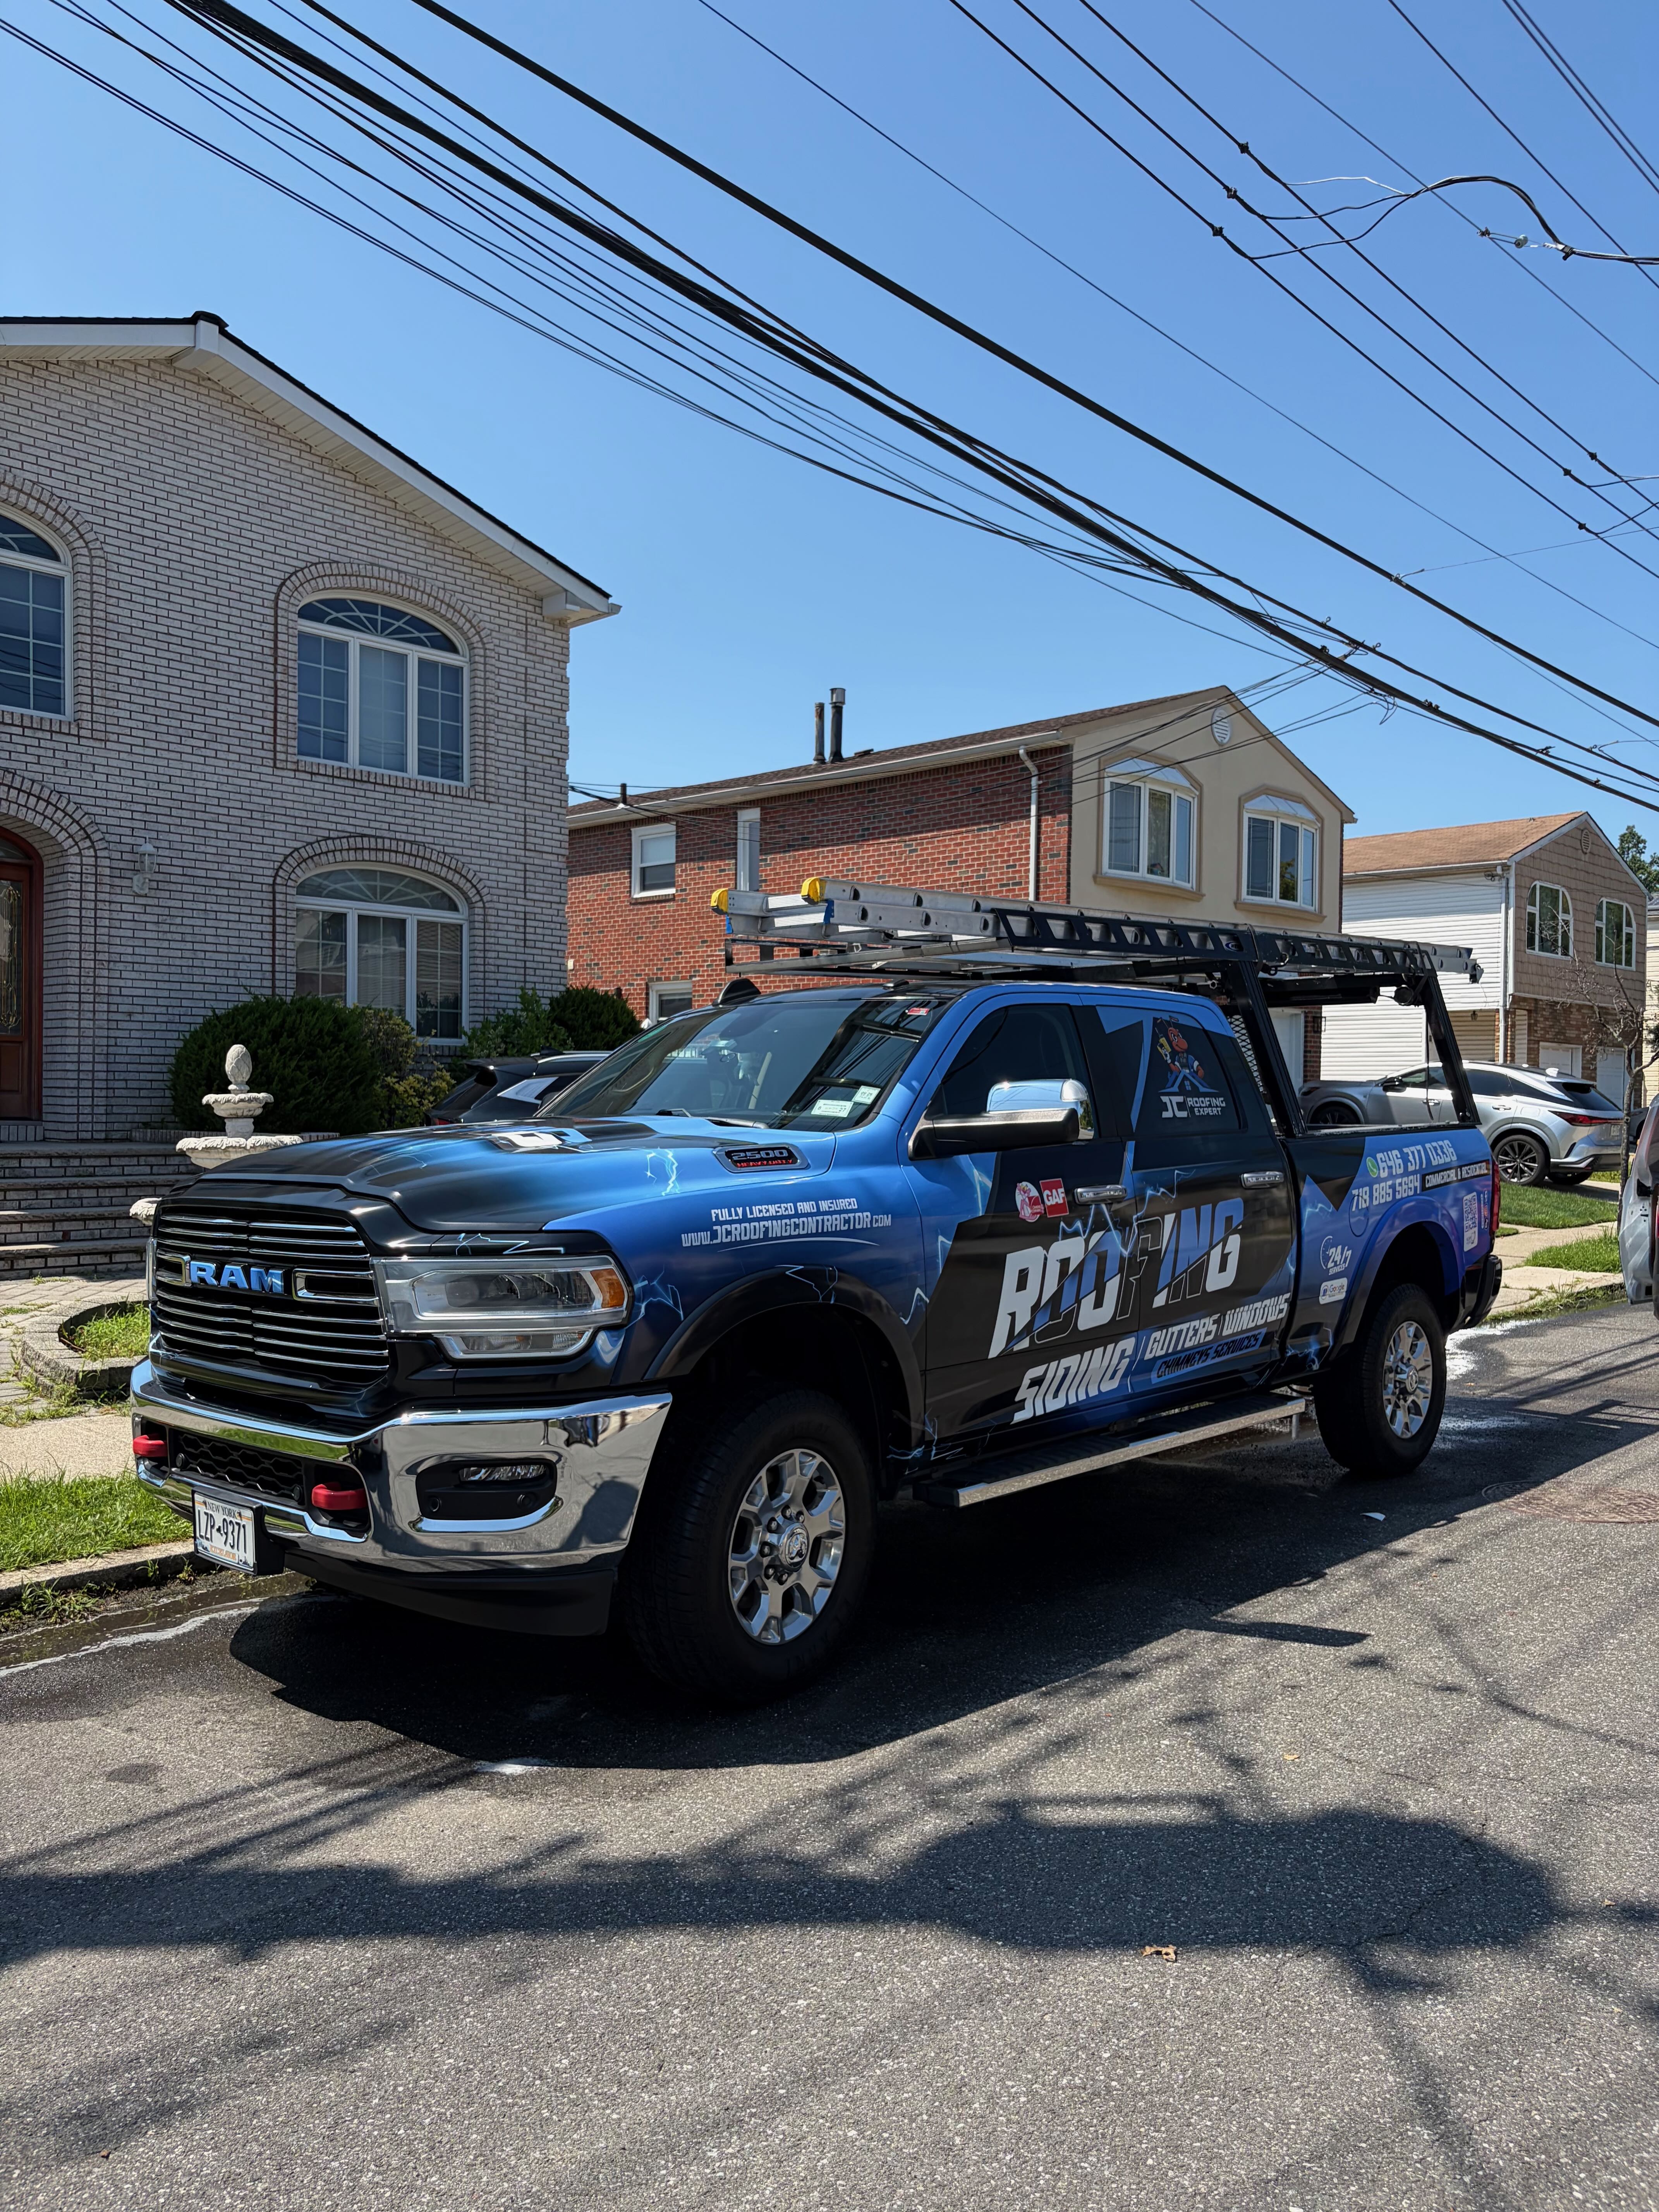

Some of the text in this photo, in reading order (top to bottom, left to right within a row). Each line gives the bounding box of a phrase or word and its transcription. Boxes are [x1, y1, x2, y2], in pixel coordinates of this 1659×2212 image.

[1160, 1096, 1226, 1118] JC ROOFING
[732, 1149, 788, 1160] 2500
[1376, 1140, 1457, 1178] 646 377 0336
[1425, 1163, 1487, 1188] COMMERCIAL & RESIDENTIAL
[1043, 1188, 1064, 1206] GAF
[1352, 1174, 1420, 1211] 718 885 5694
[711, 1198, 858, 1221] FULLY LICENSED AND INSURED
[1327, 1245, 1352, 1269] 24/7
[1329, 1263, 1345, 1275] SERVICES
[190, 1261, 285, 1293] RAM
[988, 1197, 1243, 1358] ROOFING
[1010, 1293, 1291, 1425] SIDING GUTTERS WINDOWS
[1156, 1332, 1262, 1379] CHIMNEYS SERVICES
[207, 1501, 237, 1518] NEW YORK
[198, 1510, 215, 1543] LZP
[222, 1518, 247, 1554] 9371
